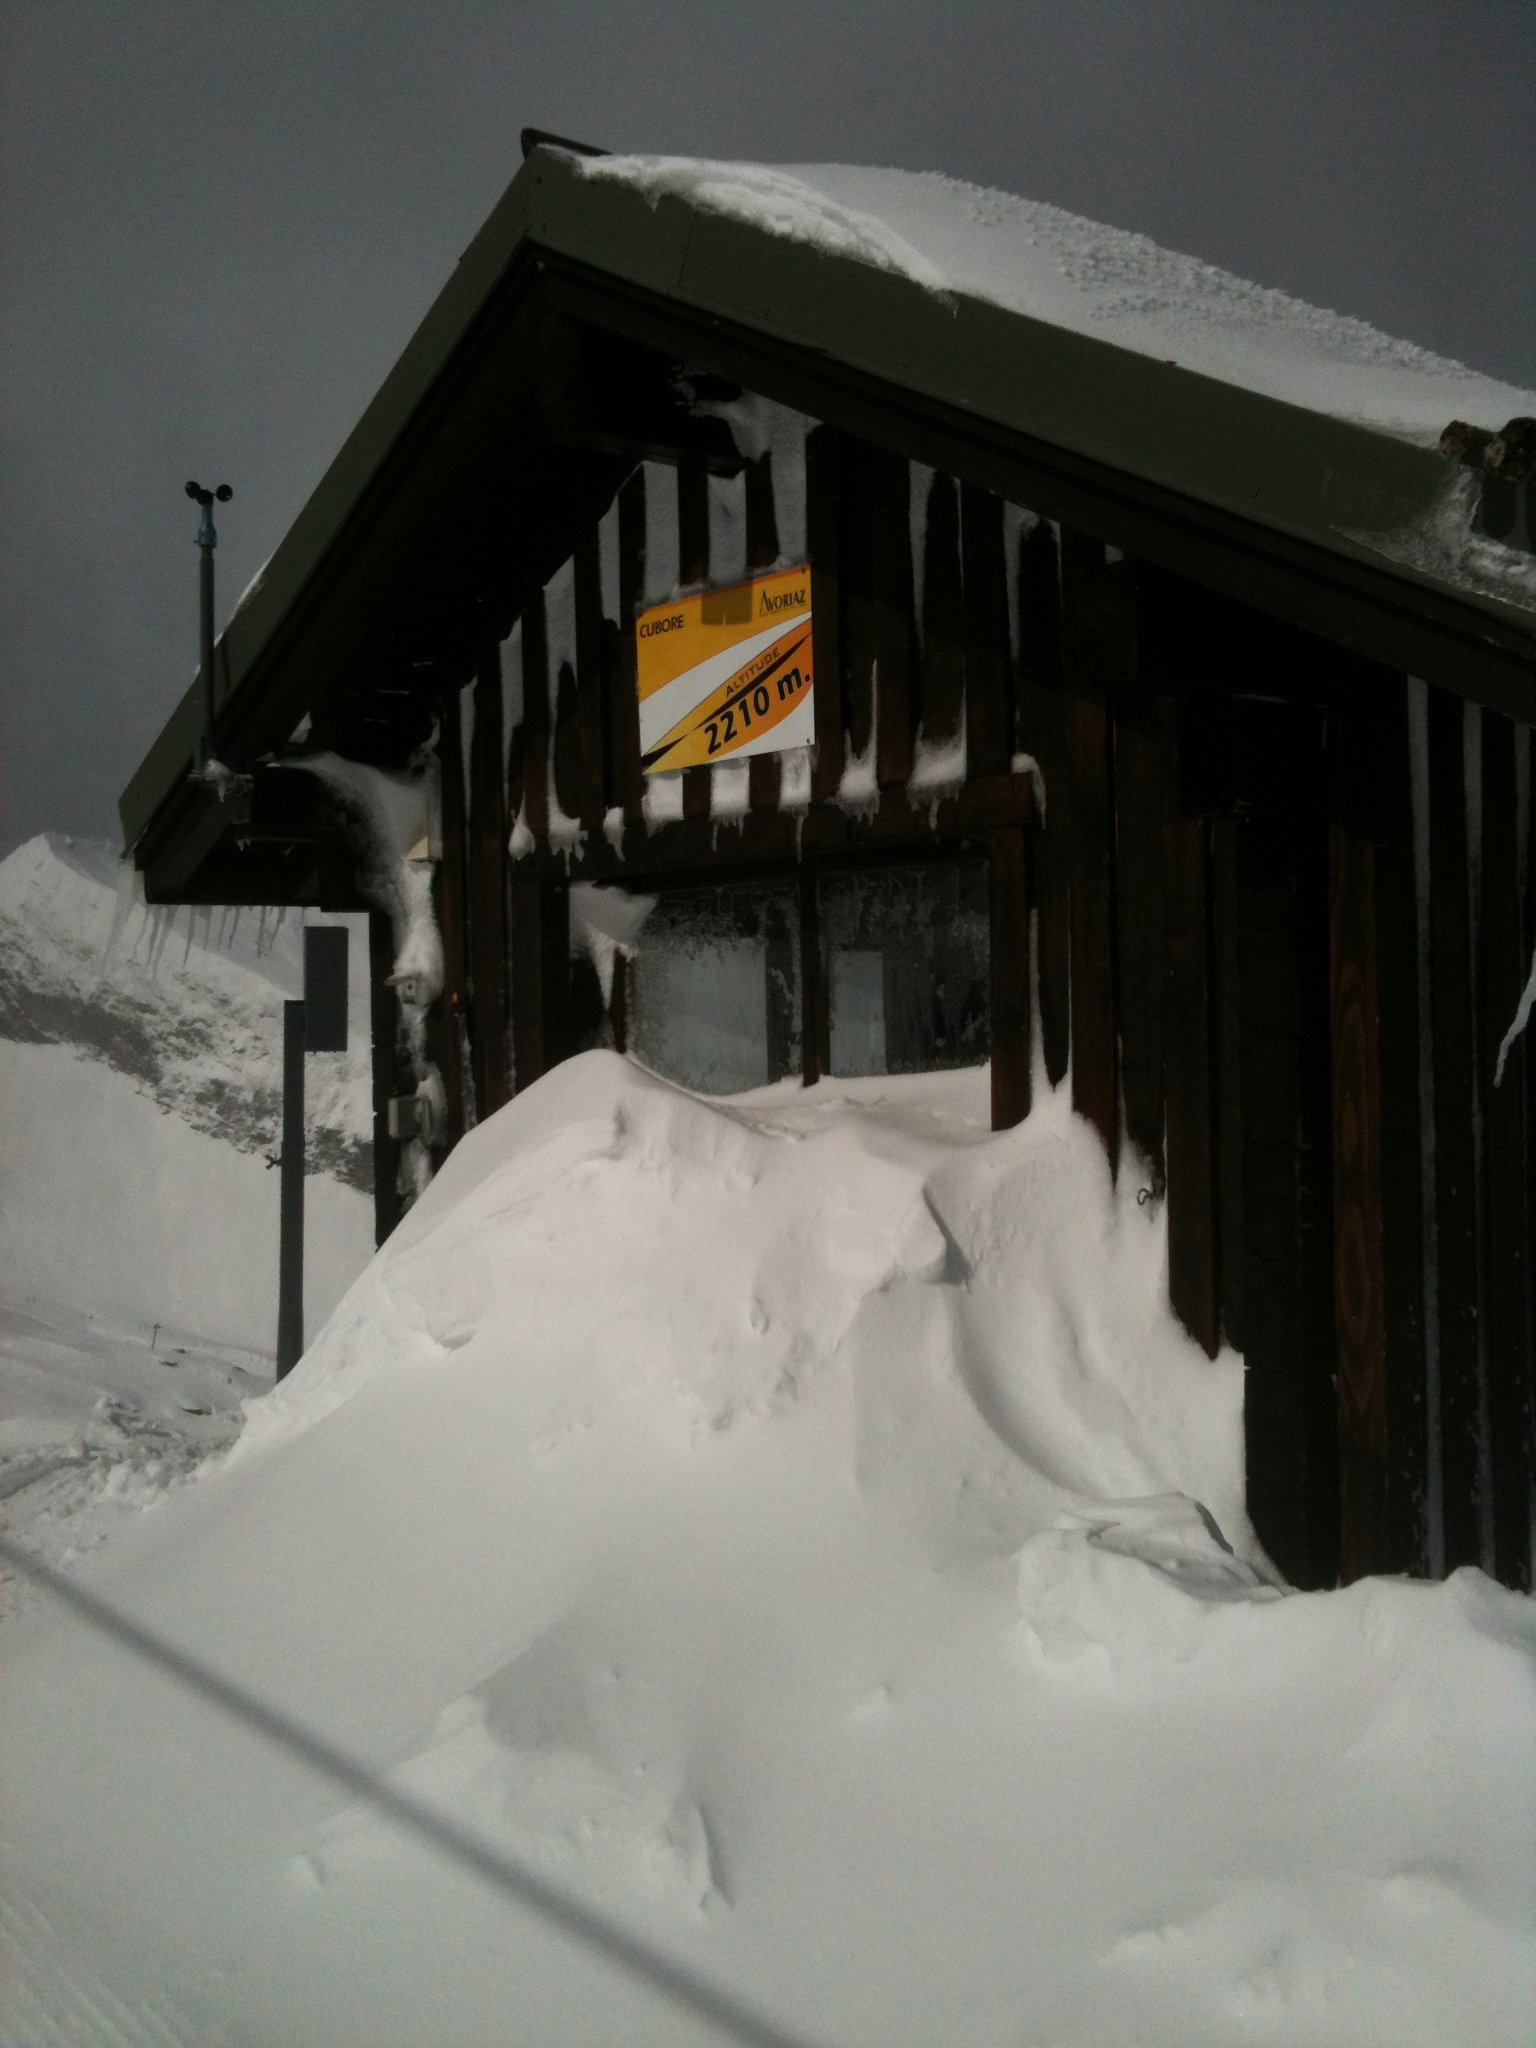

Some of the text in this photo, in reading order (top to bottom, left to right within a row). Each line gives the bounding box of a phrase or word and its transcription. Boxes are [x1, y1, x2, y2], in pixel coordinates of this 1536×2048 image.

[759, 588, 806, 614] AVORIAZ
[639, 614, 685, 639] CUBORE
[725, 647, 780, 697] ALTITUDE
[704, 666, 811, 755] 2210 m.
